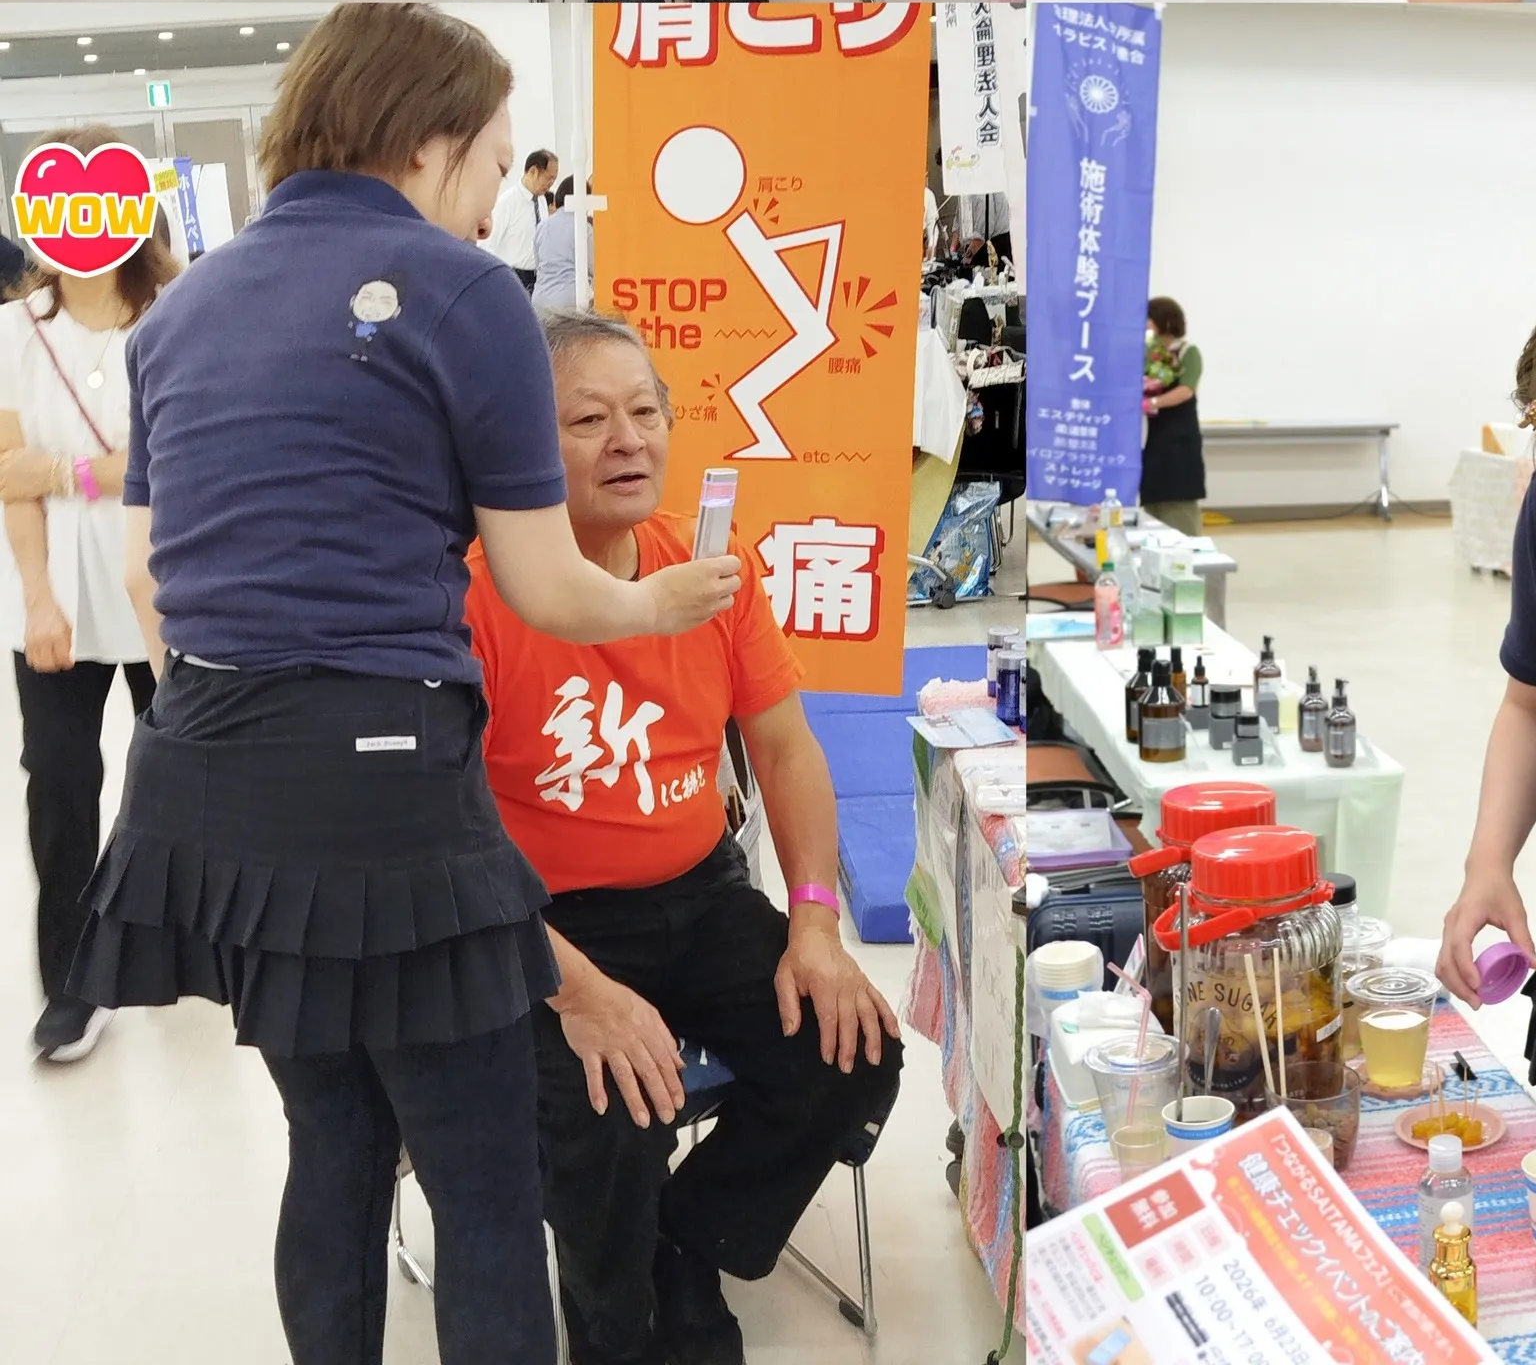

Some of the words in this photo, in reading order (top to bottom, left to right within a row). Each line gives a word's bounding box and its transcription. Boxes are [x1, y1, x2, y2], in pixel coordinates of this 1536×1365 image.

[757, 176, 803, 193] 肩こり
[1068, 157, 1107, 382] 施術体験ブース
[612, 278, 728, 312] STOP
[637, 316, 702, 350] the
[674, 405, 718, 422] ひざ痛
[802, 450, 831, 464] etc
[752, 517, 886, 641] 痛
[534, 675, 665, 816] 新
